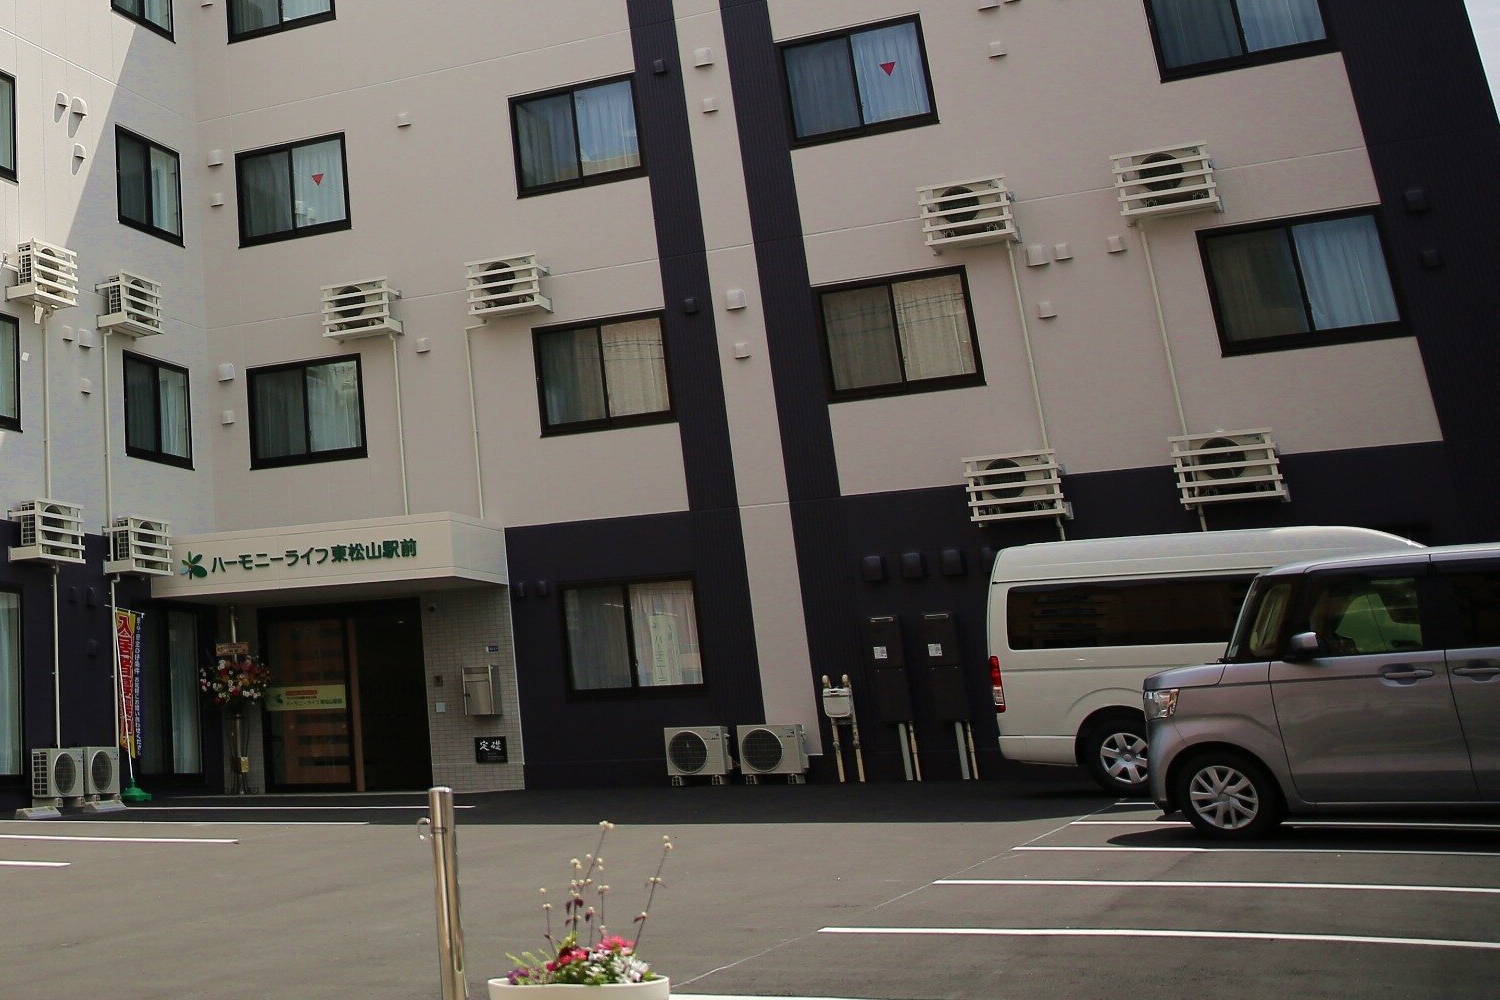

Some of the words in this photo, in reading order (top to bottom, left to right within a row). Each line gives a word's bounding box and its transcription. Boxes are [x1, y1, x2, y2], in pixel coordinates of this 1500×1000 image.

[211, 538, 417, 573] ハーモニーライフ東松山駅前
[479, 740, 502, 751] 定礎
